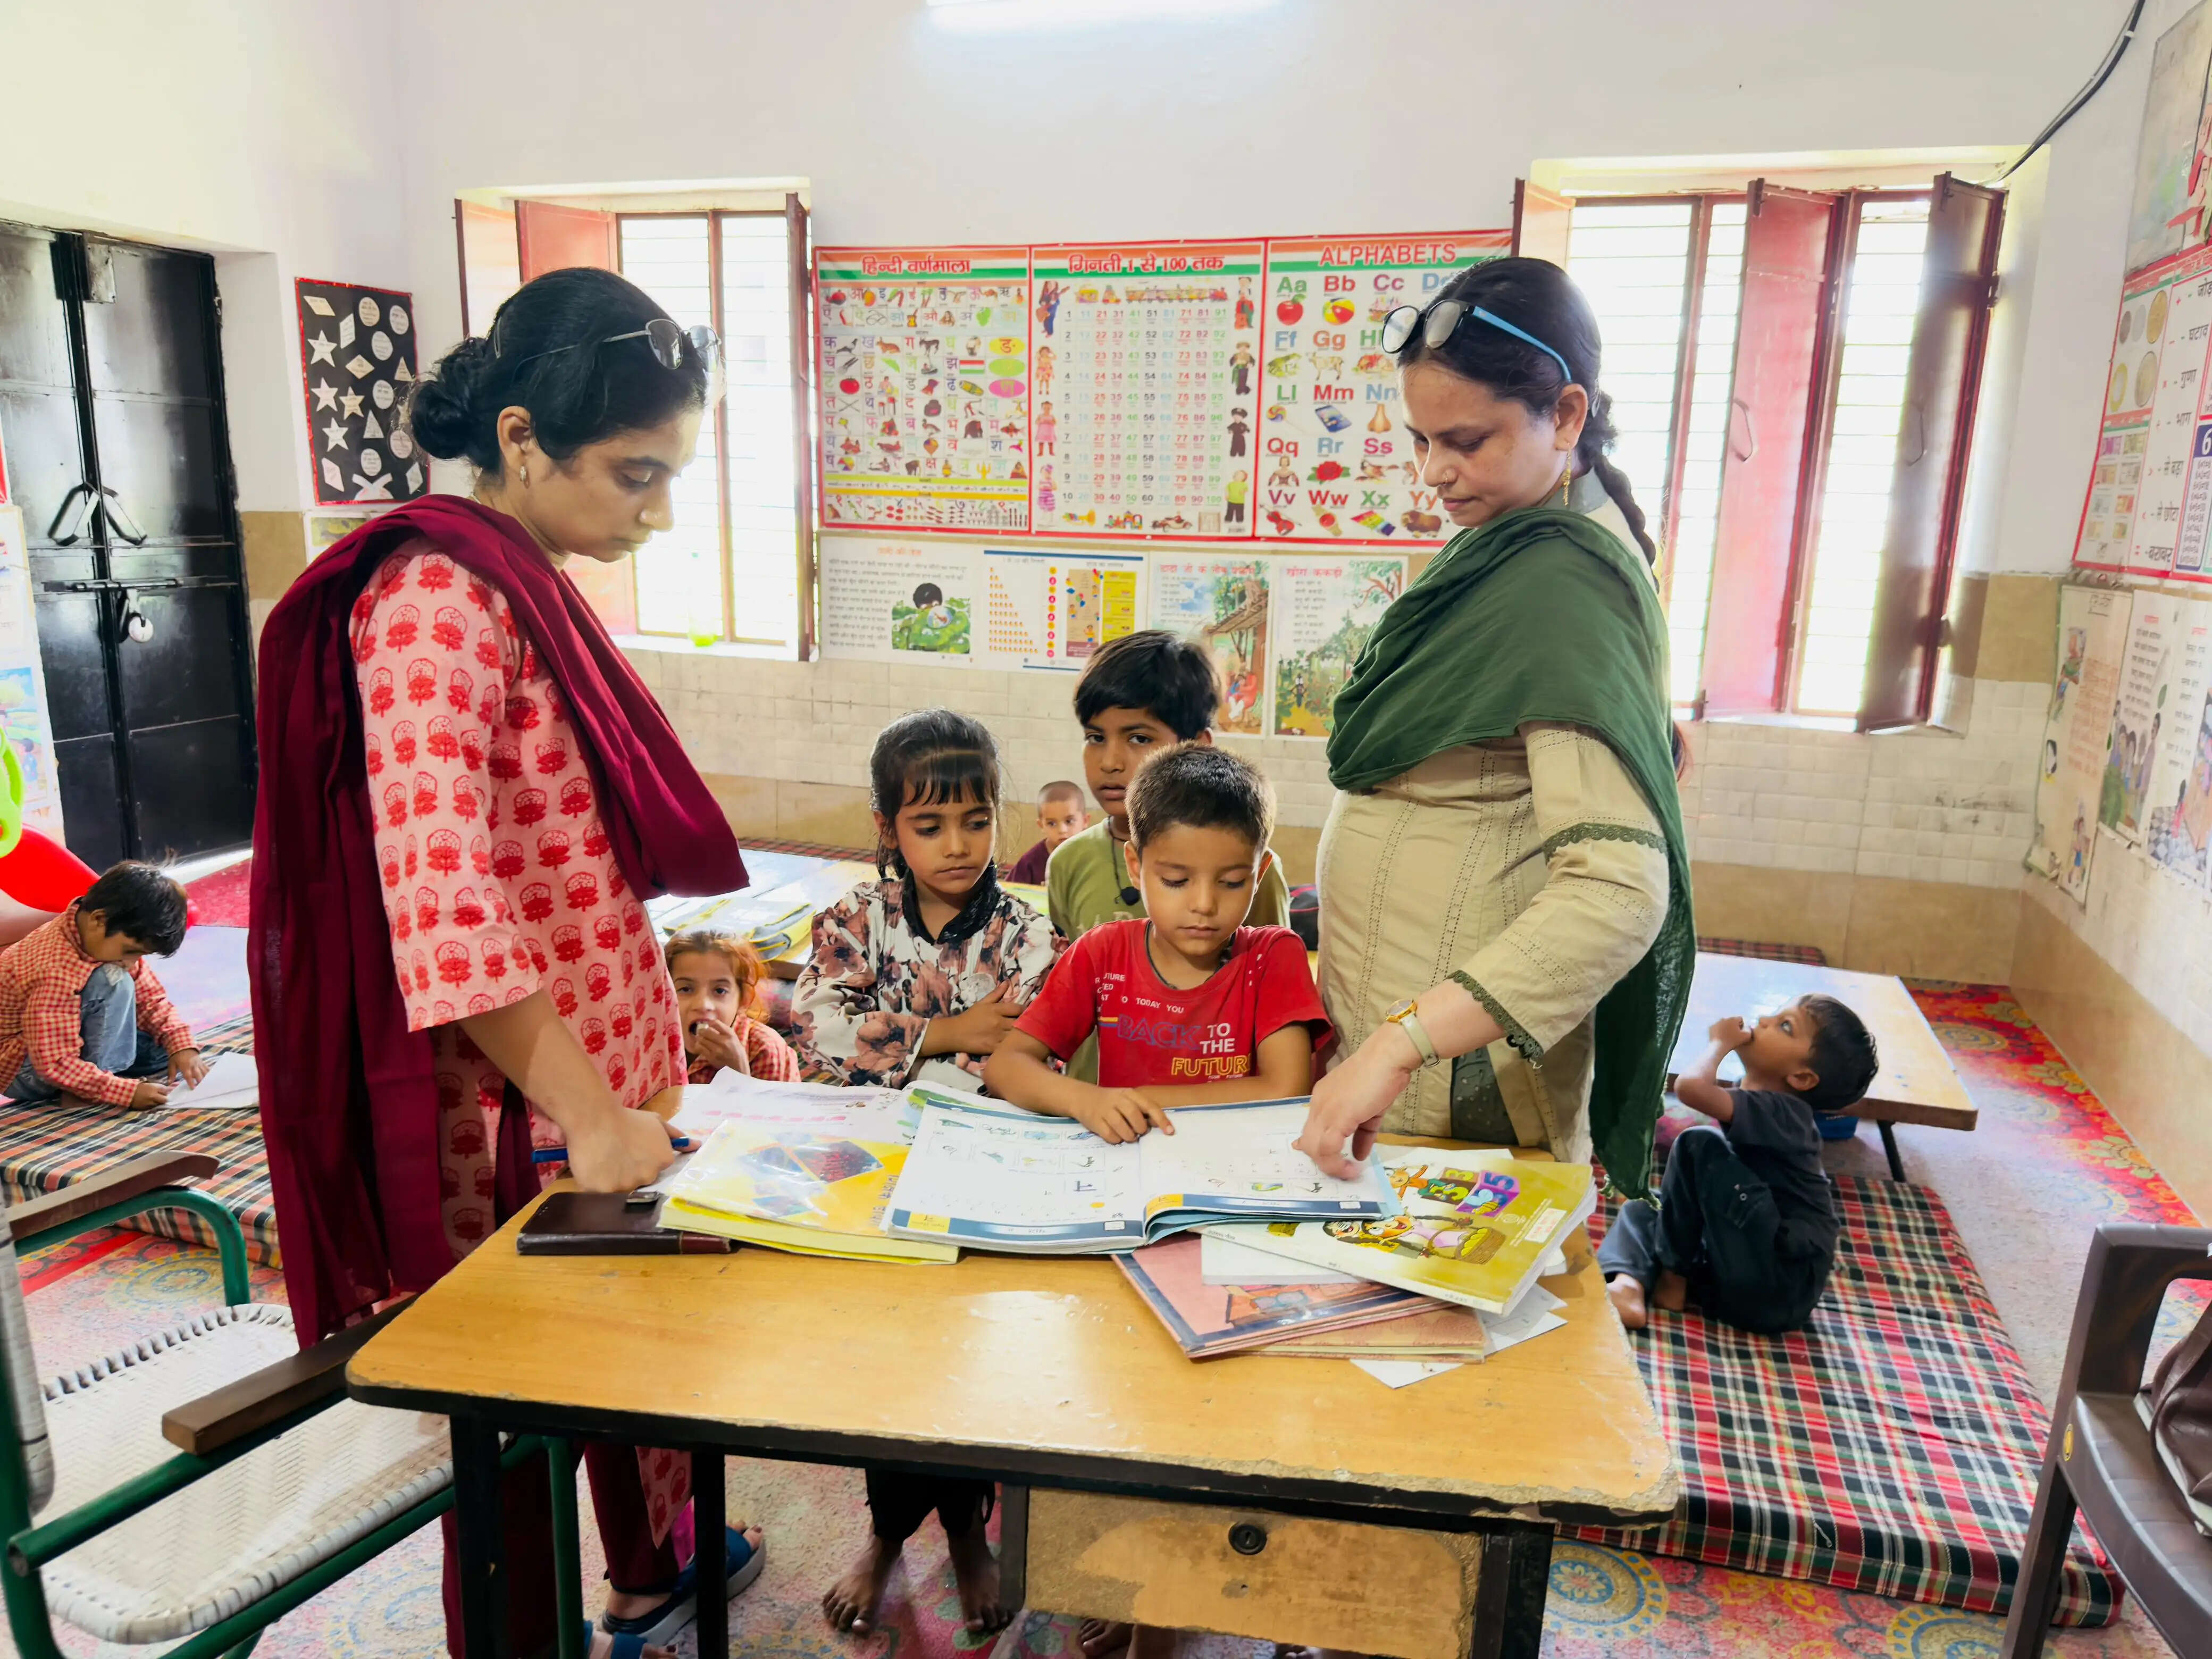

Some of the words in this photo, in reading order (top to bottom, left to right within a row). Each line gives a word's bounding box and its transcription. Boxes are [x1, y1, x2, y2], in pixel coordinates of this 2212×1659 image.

[862, 256, 902, 274] हिन्दी
[907, 256, 970, 274] वर्णमाला
[1069, 254, 1122, 273] गिनती
[1140, 254, 1157, 272] से
[1163, 257, 1187, 271] 100
[1192, 256, 1225, 271] तक
[1319, 244, 1457, 266] ALPHABETS
[1277, 276, 1307, 293] Aa
[1324, 275, 1356, 292] Bb
[1373, 274, 1404, 291] Cc
[1275, 331, 1297, 348] Ff
[1312, 330, 1346, 351] Gg
[2181, 369, 2197, 389] गुणा
[1277, 384, 1296, 401] Ll
[1313, 384, 1354, 401] Mm
[1365, 384, 1398, 400] Nn
[1267, 438, 1299, 457] Qq
[1317, 437, 1344, 454] Rr
[1364, 438, 1393, 455] Ss
[2201, 428, 2212, 456] 6
[1268, 490, 1296, 505] Vv
[1308, 490, 1349, 506] Ww
[1361, 490, 1389, 506] Xx
[1410, 491, 1437, 510] Yy
[1135, 997, 1161, 1009] TODAY
[1166, 1004, 1185, 1014] YOU
[1117, 1013, 1202, 1050] BACK
[1206, 1023, 1231, 1038] TO
[1199, 1038, 1235, 1054] THE
[1171, 1053, 1251, 1077] FUTUR
